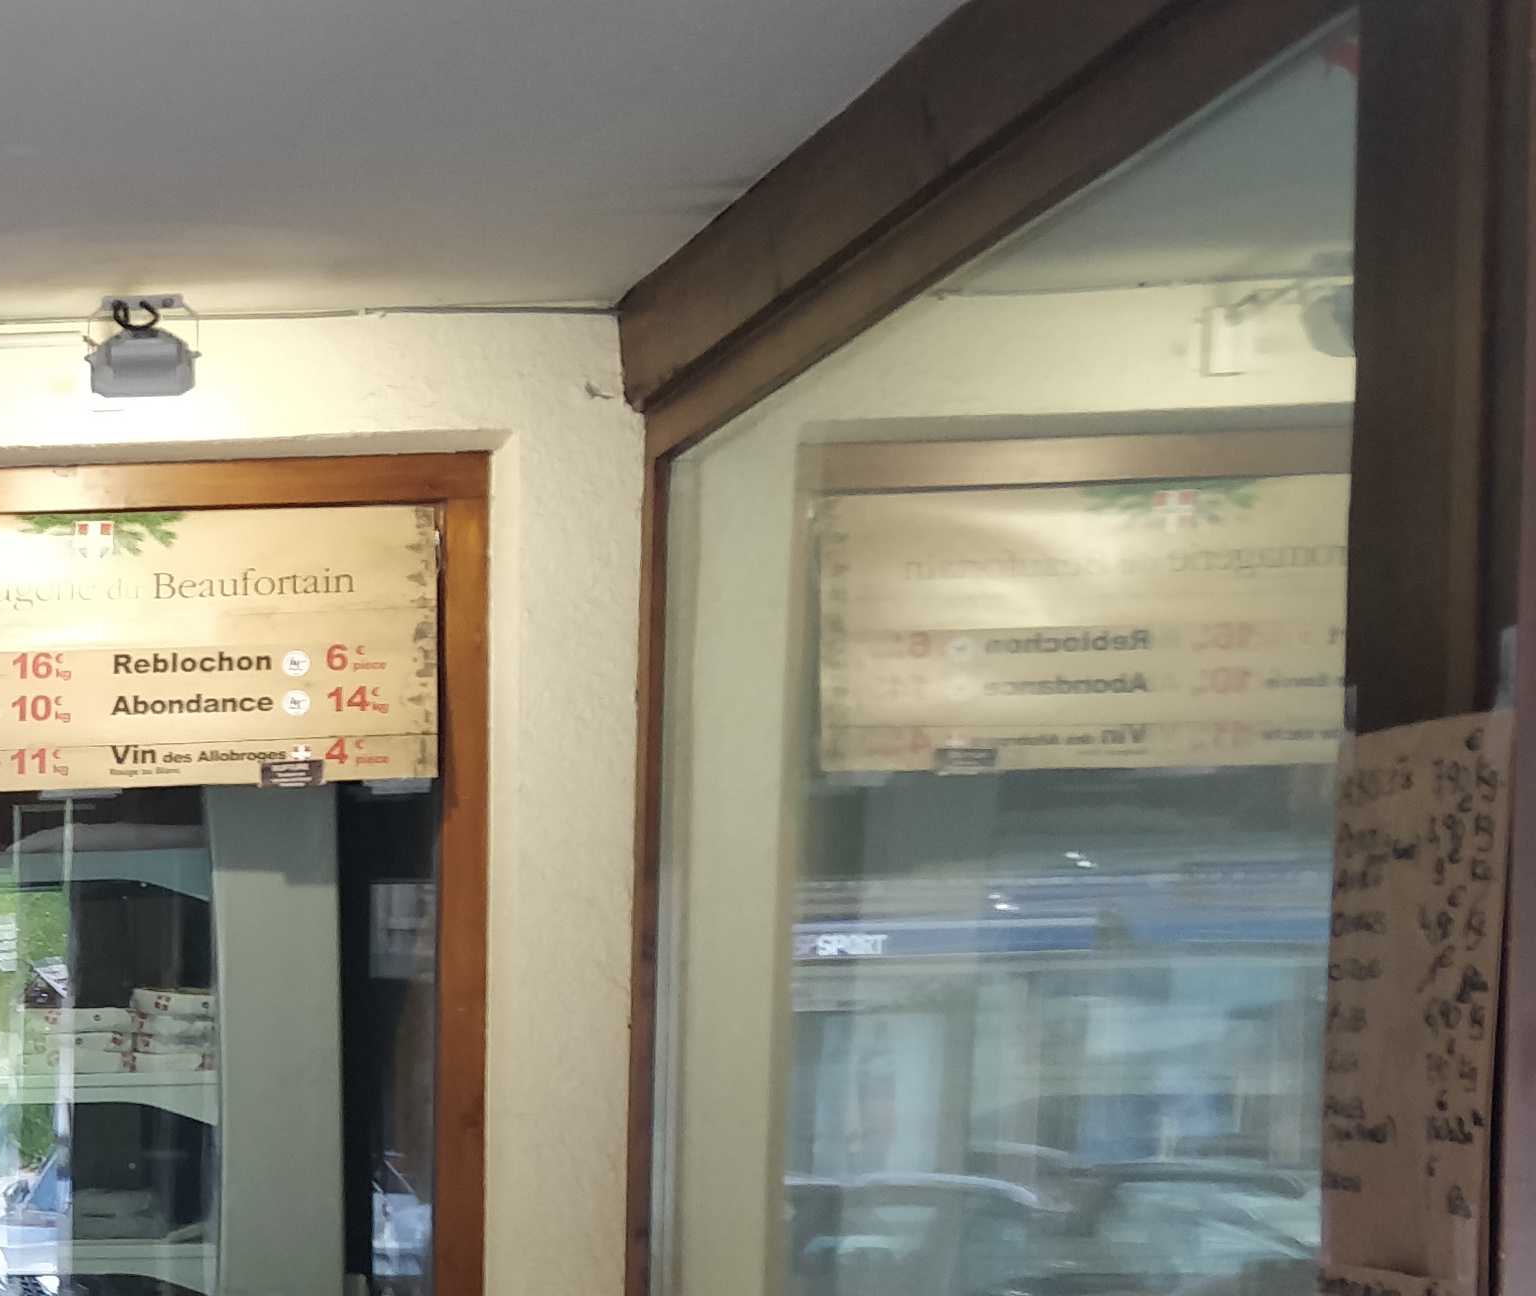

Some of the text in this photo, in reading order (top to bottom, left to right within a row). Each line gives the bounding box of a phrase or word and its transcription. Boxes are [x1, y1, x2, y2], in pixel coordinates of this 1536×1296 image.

[153, 567, 356, 600] Beaufortain
[113, 652, 272, 675] Reblochon
[110, 693, 275, 716] Abondance
[110, 745, 157, 765] Vin
[162, 751, 193, 764] des
[197, 750, 288, 765] Allobroges
